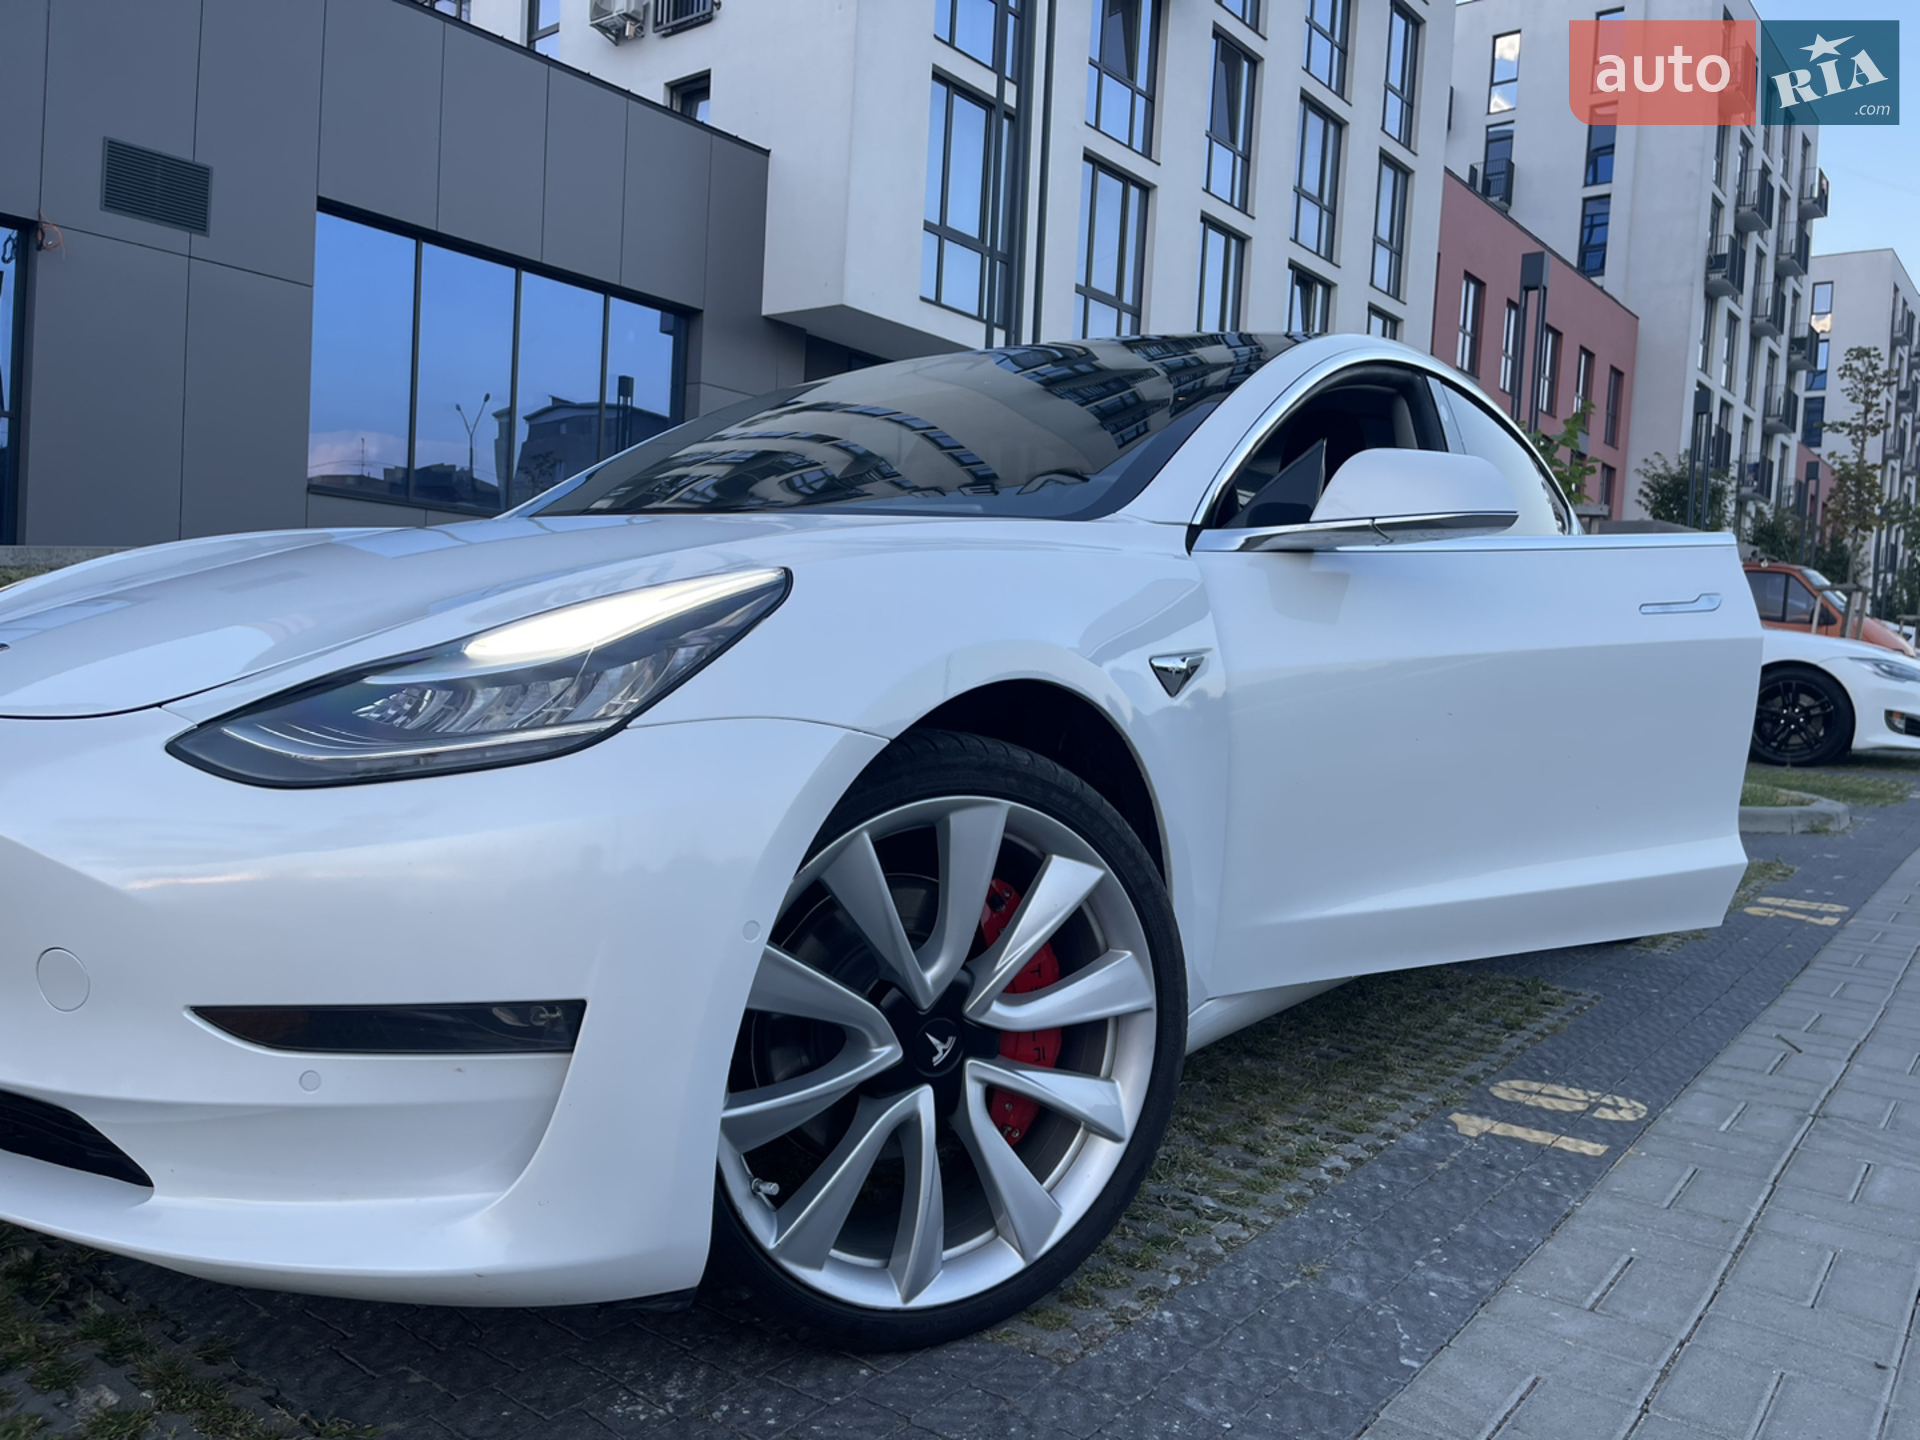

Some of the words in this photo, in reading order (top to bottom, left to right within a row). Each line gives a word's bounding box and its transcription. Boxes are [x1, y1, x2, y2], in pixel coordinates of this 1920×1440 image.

[1049, 788, 1151, 888] MICHELIN
[1743, 896, 1850, 926] 20
[1448, 1079, 1648, 1157] 19
